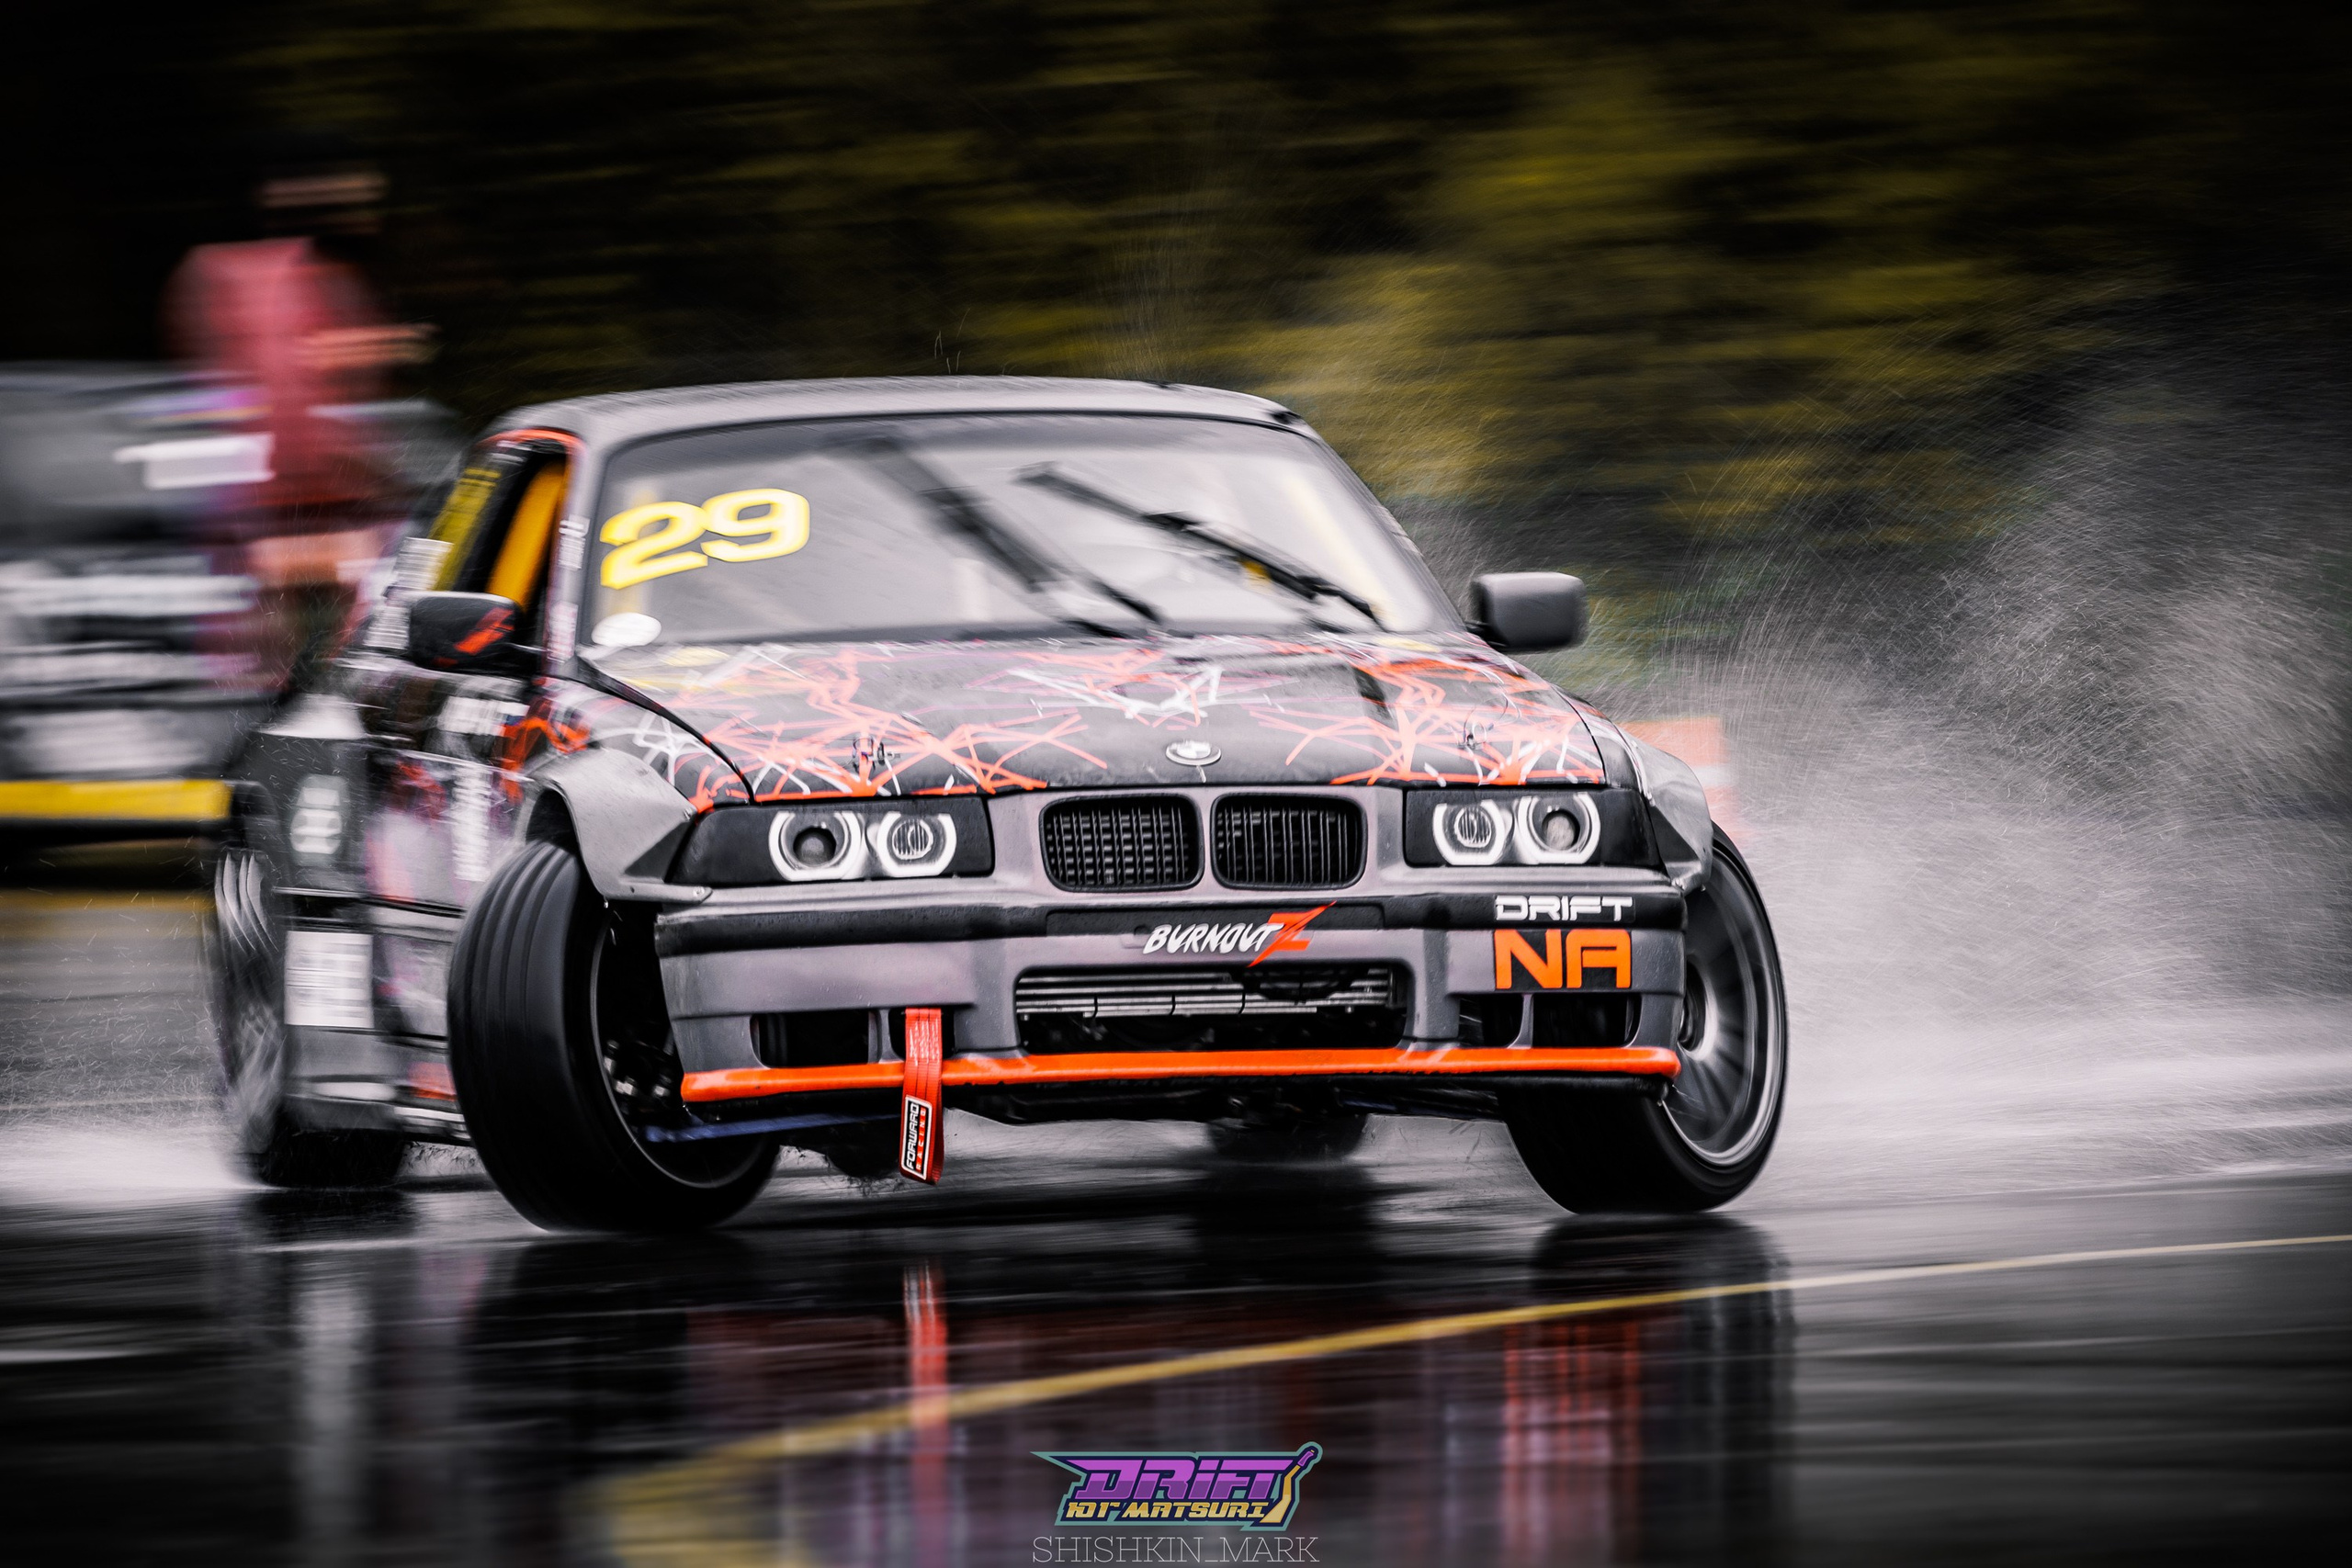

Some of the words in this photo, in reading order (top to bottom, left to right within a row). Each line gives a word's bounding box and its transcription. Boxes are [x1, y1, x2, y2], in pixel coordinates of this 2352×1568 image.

[599, 488, 810, 591] 29
[1495, 895, 1633, 921] DRIFT
[1494, 928, 1632, 989] NA
[906, 1102, 920, 1169] FORWARD
[916, 1108, 927, 1170] RACING
